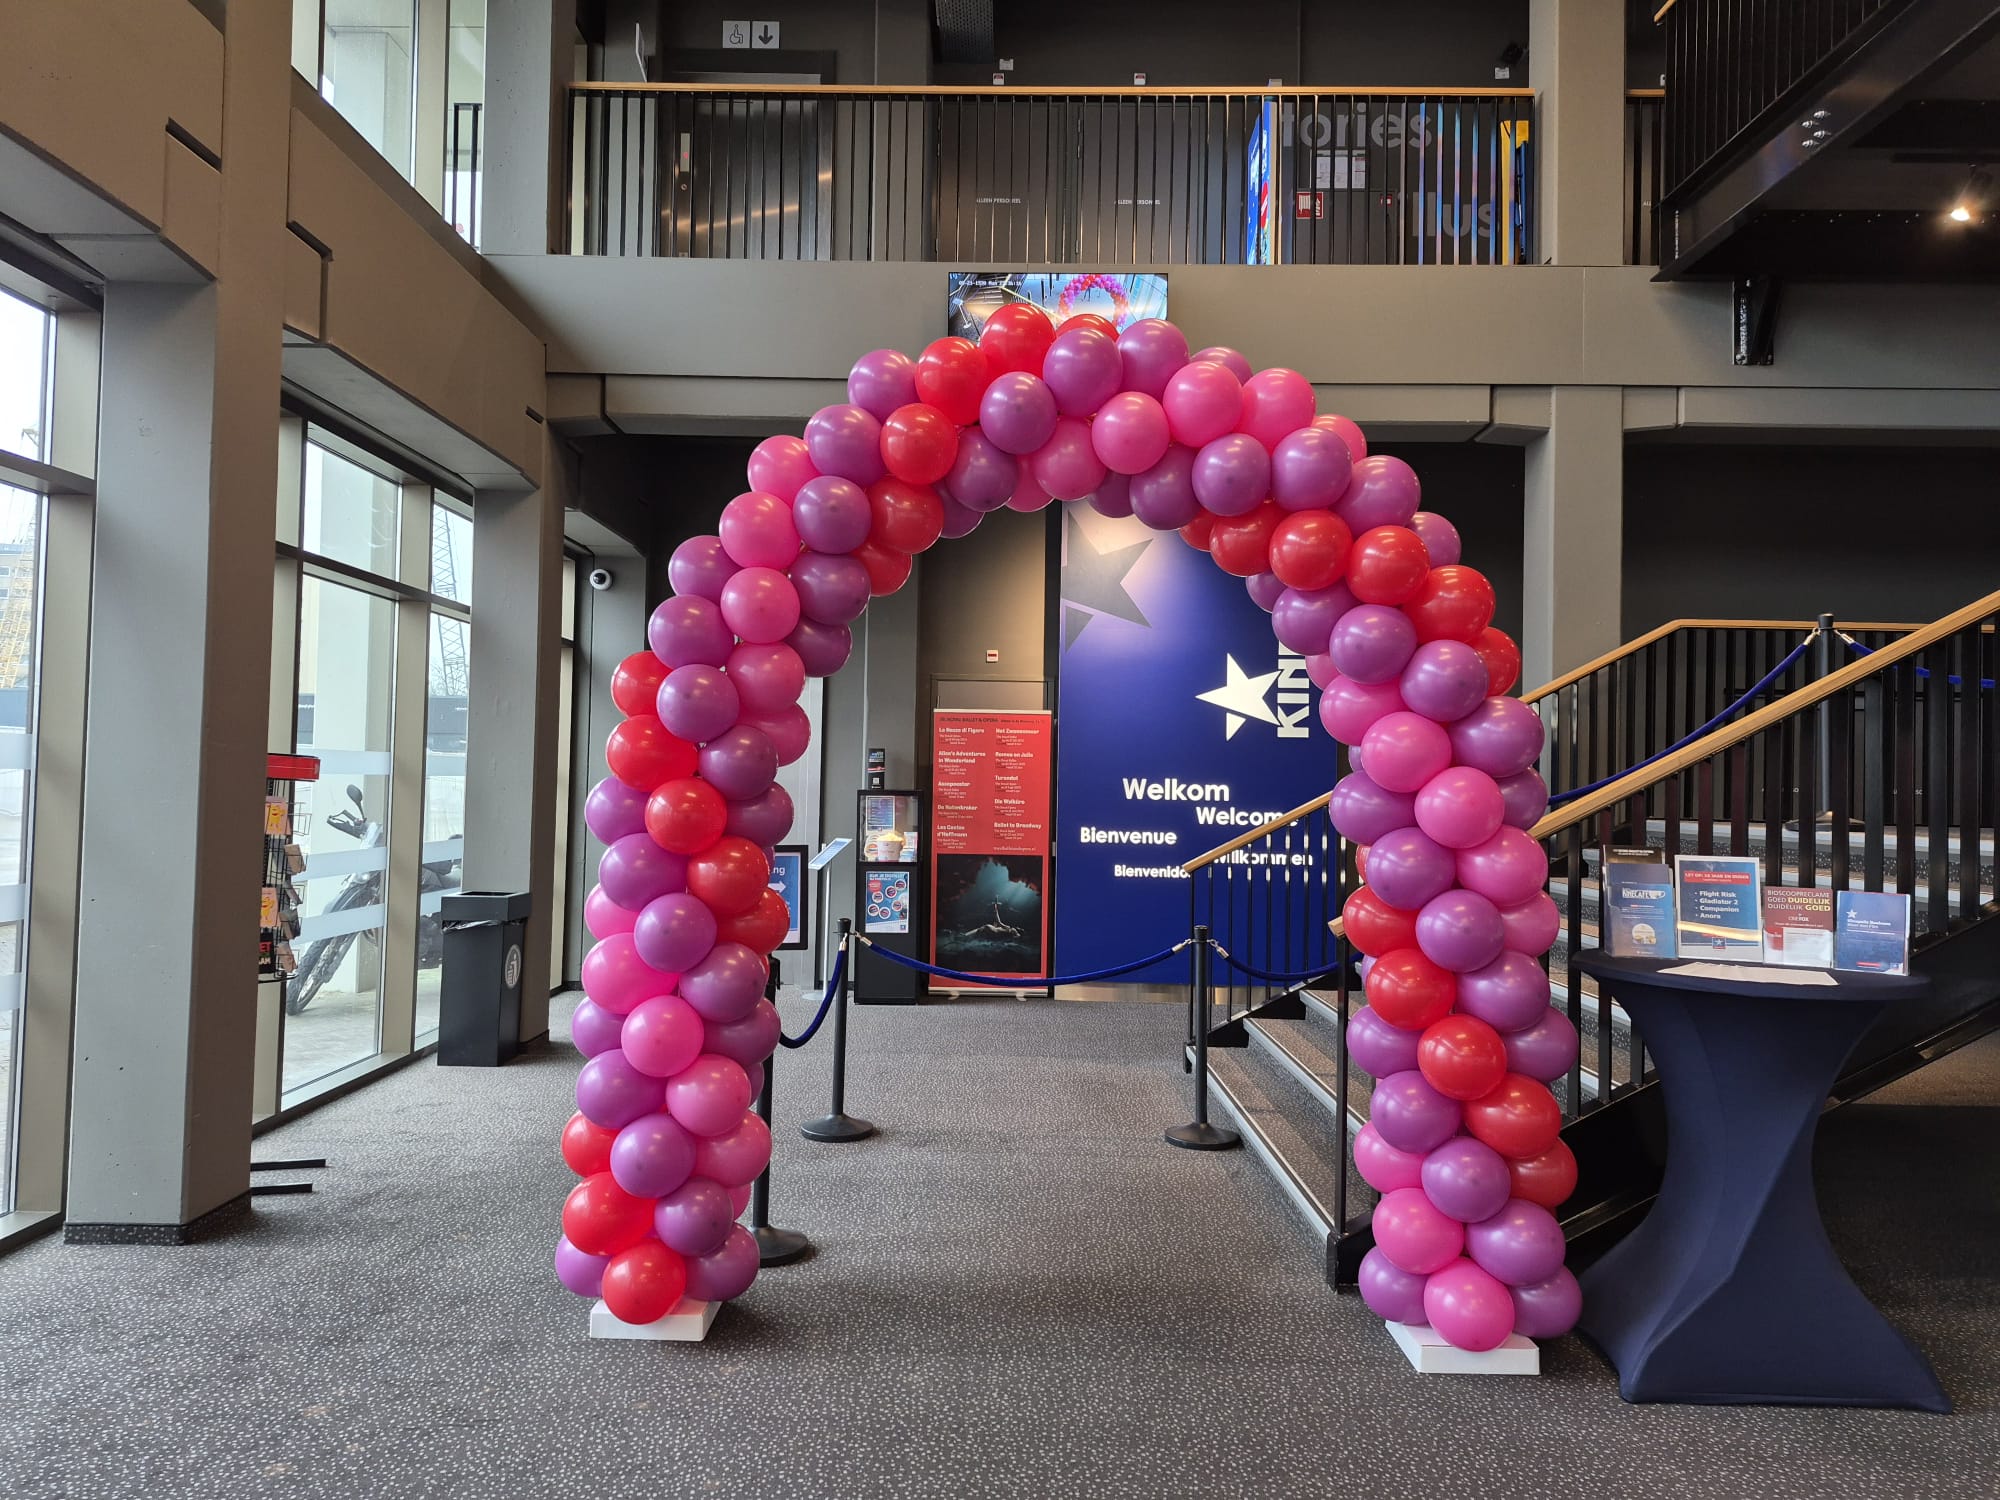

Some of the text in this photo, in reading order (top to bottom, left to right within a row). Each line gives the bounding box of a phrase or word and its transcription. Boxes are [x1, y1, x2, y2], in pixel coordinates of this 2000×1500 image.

[1281, 102, 1432, 148] tories
[1277, 640, 1310, 738] KIN
[1122, 777, 1230, 802] Welkom
[1080, 826, 1177, 845] Bienvenue
[1113, 864, 1191, 879] Bienvenido
[1767, 889, 1830, 898] BIOSCOOPRECLAME
